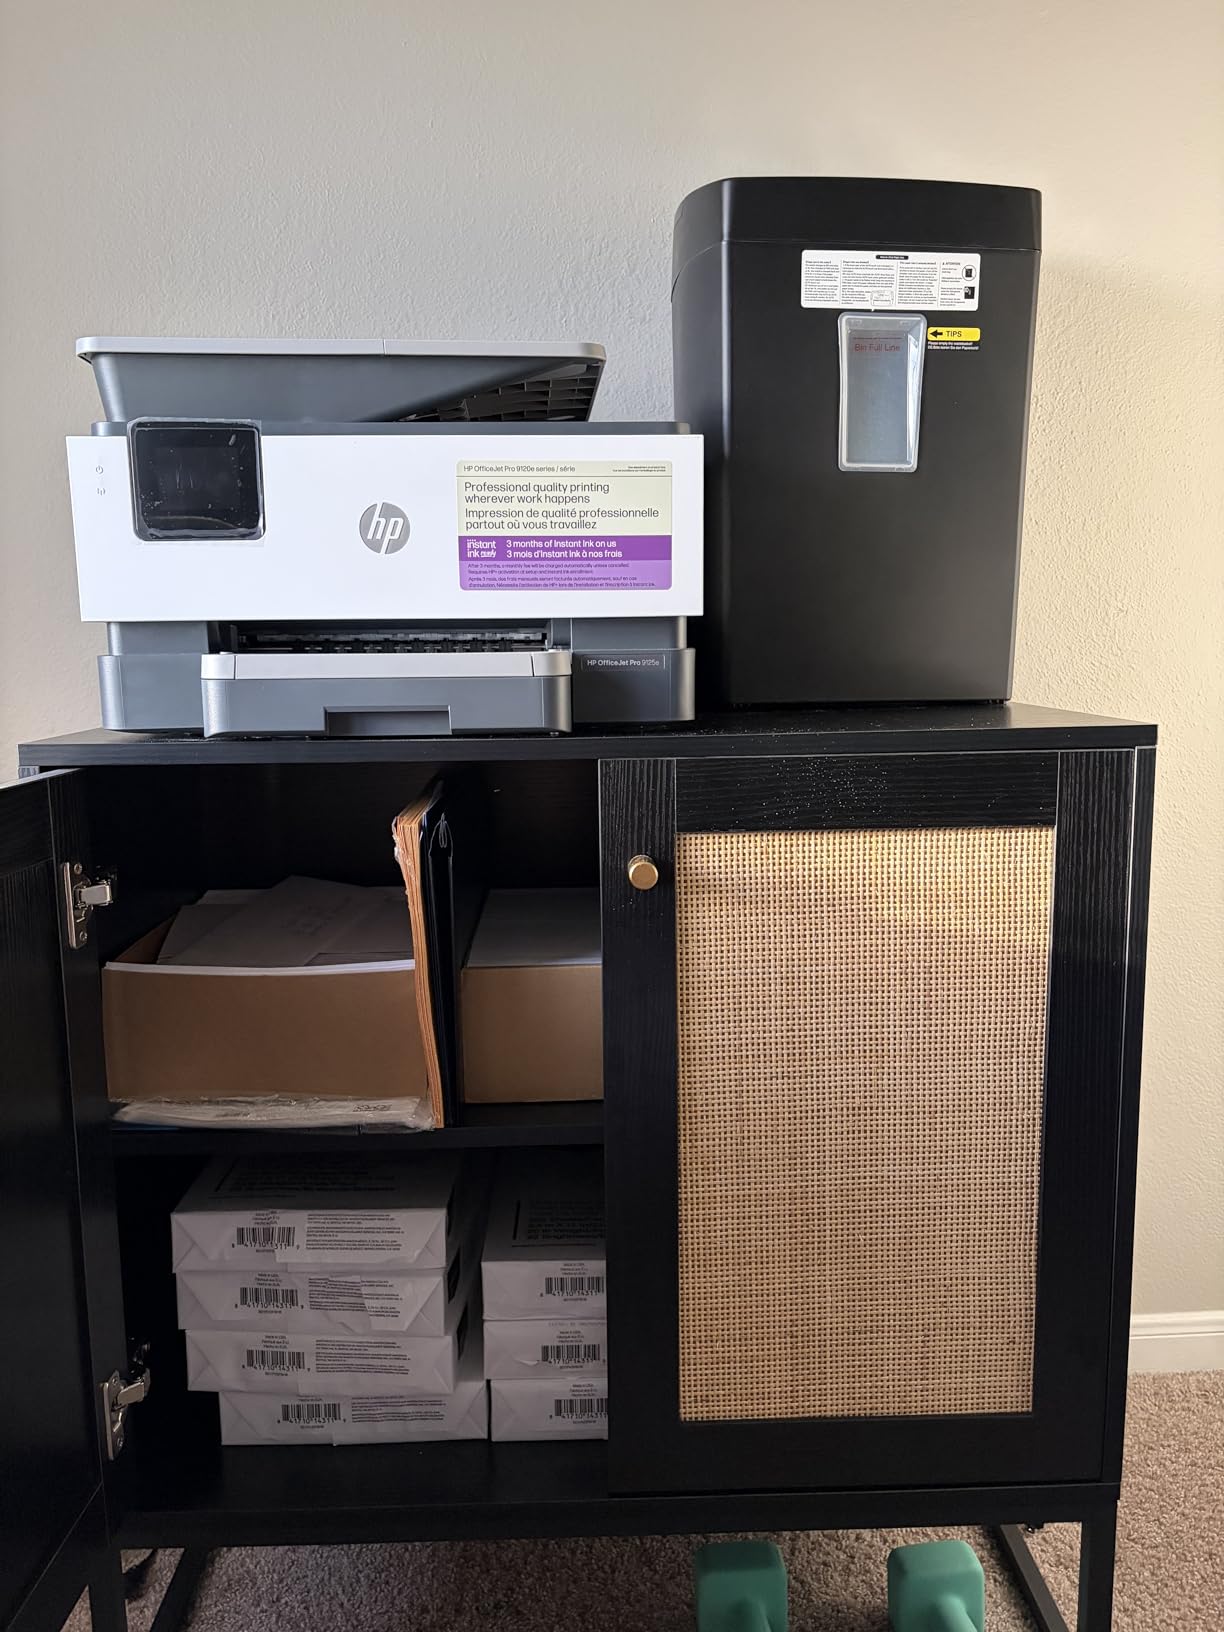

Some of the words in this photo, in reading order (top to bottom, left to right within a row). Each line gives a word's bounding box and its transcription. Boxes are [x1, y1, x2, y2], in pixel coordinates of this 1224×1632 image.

[464, 482, 531, 492] Professional
[533, 482, 567, 494] quality
[570, 482, 610, 494] printing
[465, 494, 514, 503] wherever
[517, 494, 542, 503] work
[545, 494, 590, 506] happens
[465, 508, 524, 520] Impression
[526, 508, 539, 518] de
[541, 508, 576, 520] qualité
[579, 508, 659, 520] professionnelle
[364, 502, 406, 554] hp
[466, 520, 505, 531] partout
[507, 520, 520, 529] où
[550, 519, 597, 529] travaillez
[467, 539, 496, 549] instant
[506, 540, 512, 548] 3
[513, 540, 542, 548] months
[544, 540, 552, 548] of
[554, 540, 582, 548] Instant
[583, 540, 594, 548] Ink
[595, 540, 606, 548] on
[607, 540, 617, 548] us
[467, 549, 480, 558] ink
[506, 550, 512, 558] 3
[513, 550, 532, 558] mois
[534, 550, 568, 558] d'Instant
[569, 550, 581, 558] Ink
[582, 550, 588, 558] à
[589, 550, 603, 558] nos
[604, 550, 623, 558] frais
